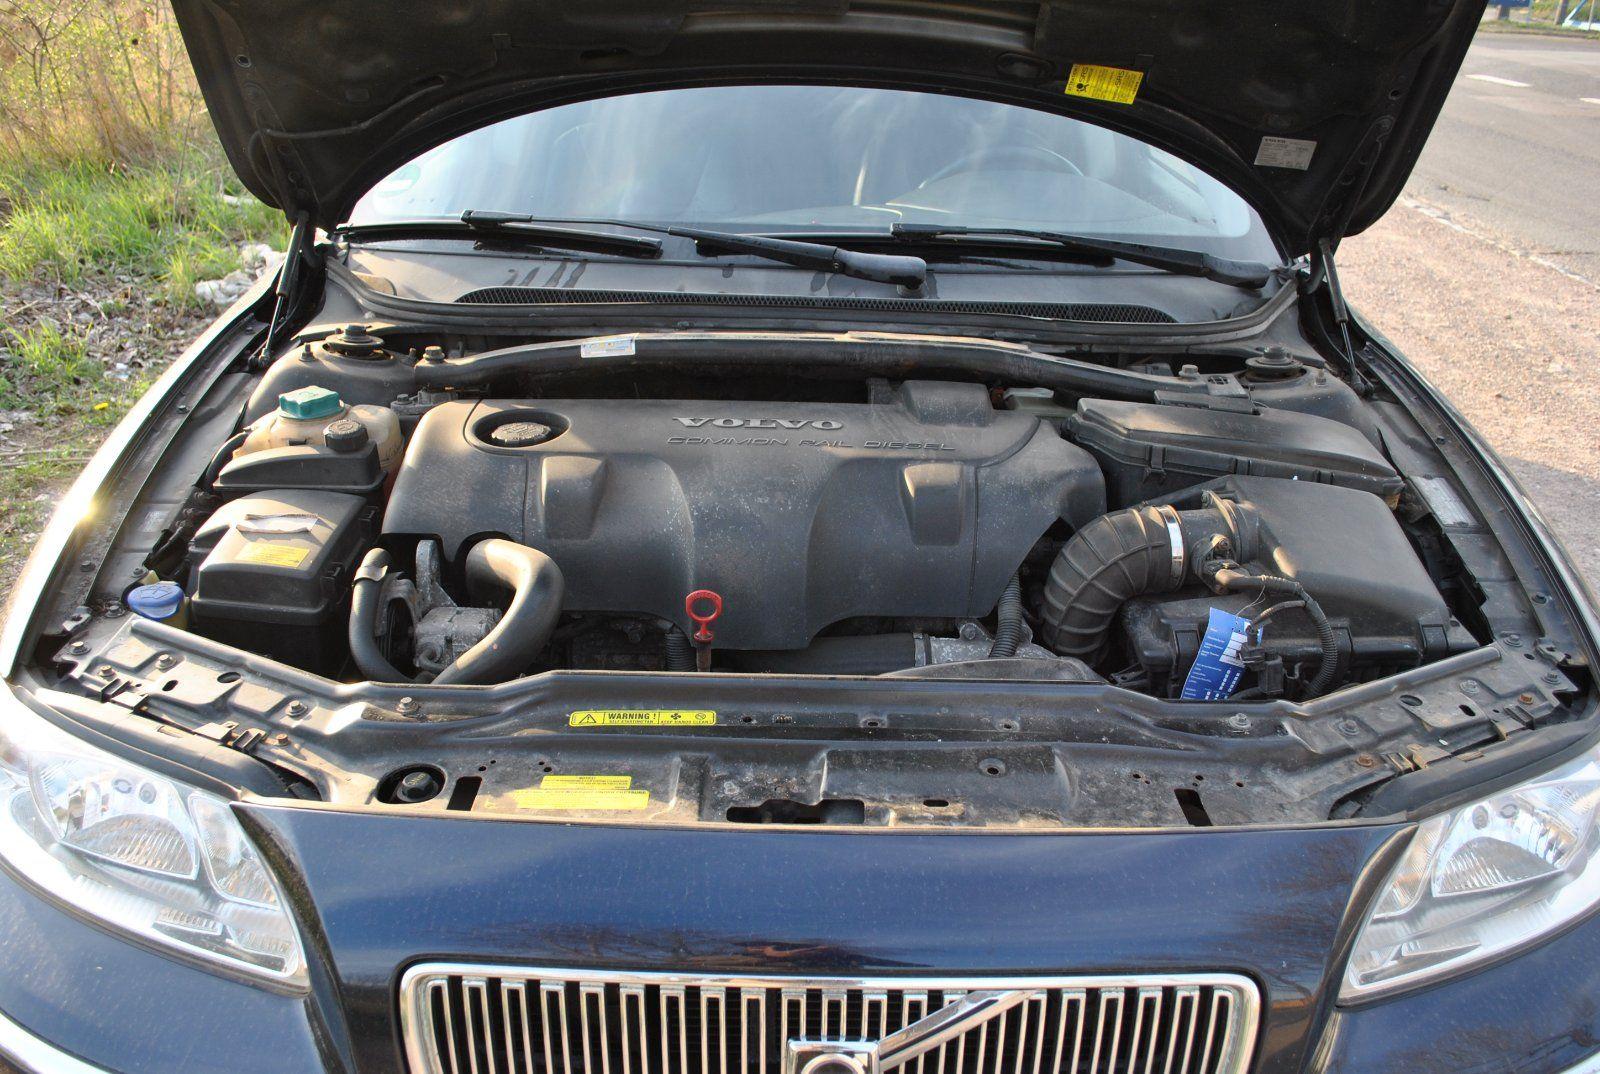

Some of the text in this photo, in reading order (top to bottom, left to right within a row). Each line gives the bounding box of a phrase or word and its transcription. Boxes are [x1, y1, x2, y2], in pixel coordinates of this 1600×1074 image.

[672, 417, 844, 431] VOLVO
[666, 436, 957, 452] COMMON RAIL DIESEL
